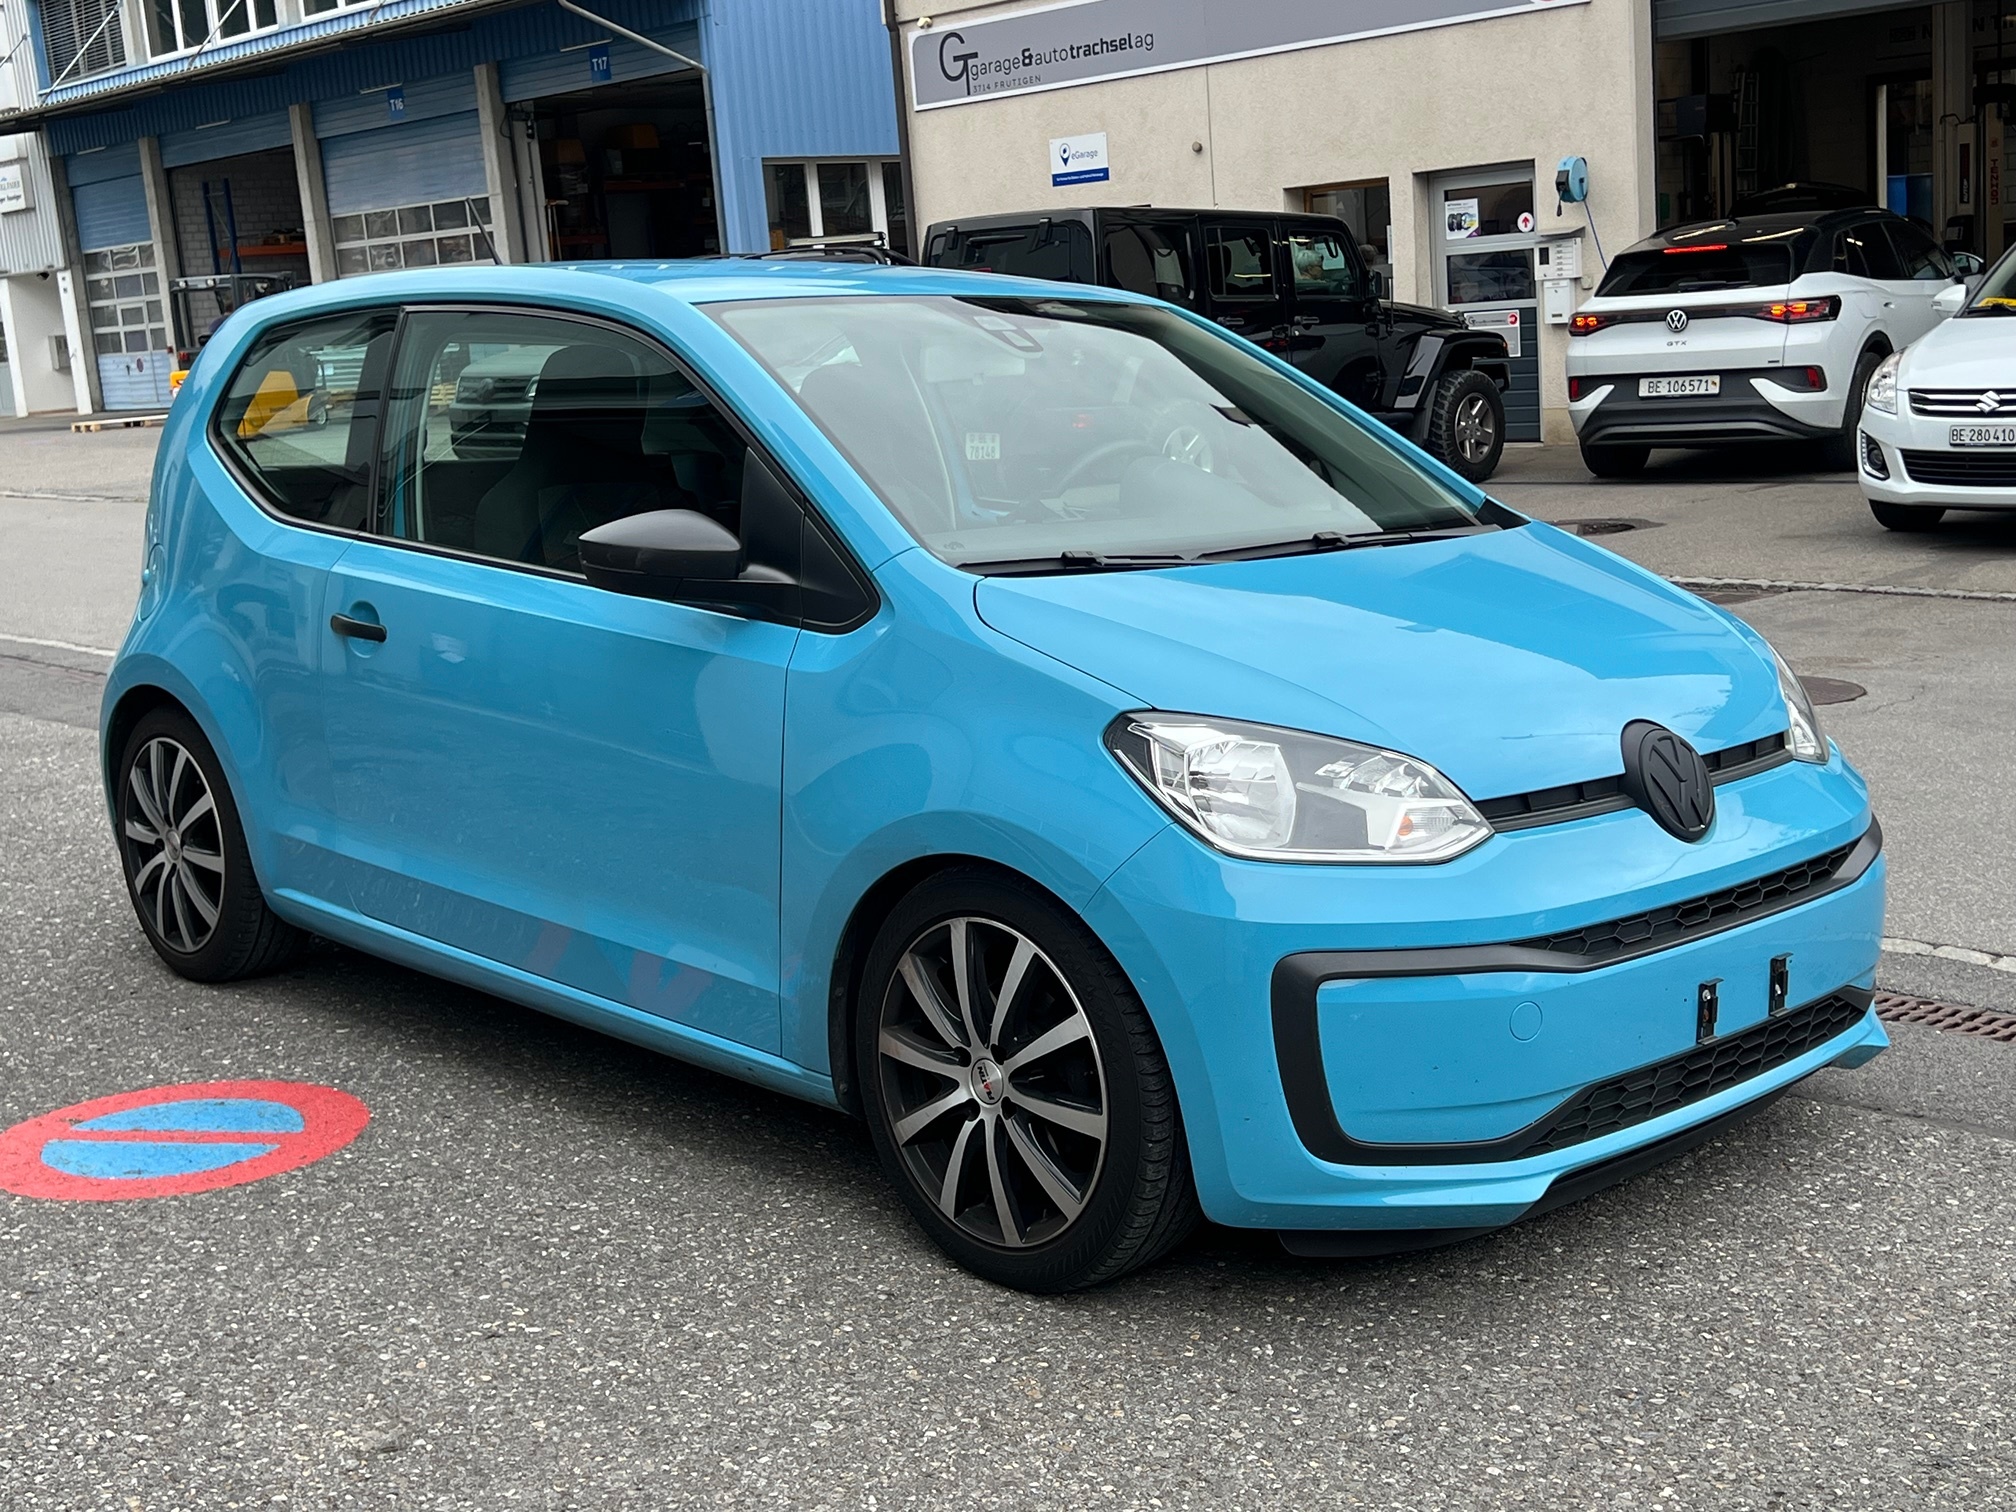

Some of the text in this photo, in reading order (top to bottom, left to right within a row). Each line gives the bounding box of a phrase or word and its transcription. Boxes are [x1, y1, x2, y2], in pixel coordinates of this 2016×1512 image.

[591, 56, 607, 71] T17
[973, 74, 1041, 93] 3714 FRUTIGEN
[389, 97, 404, 112] T16
[1071, 149, 1098, 160] eGarage
